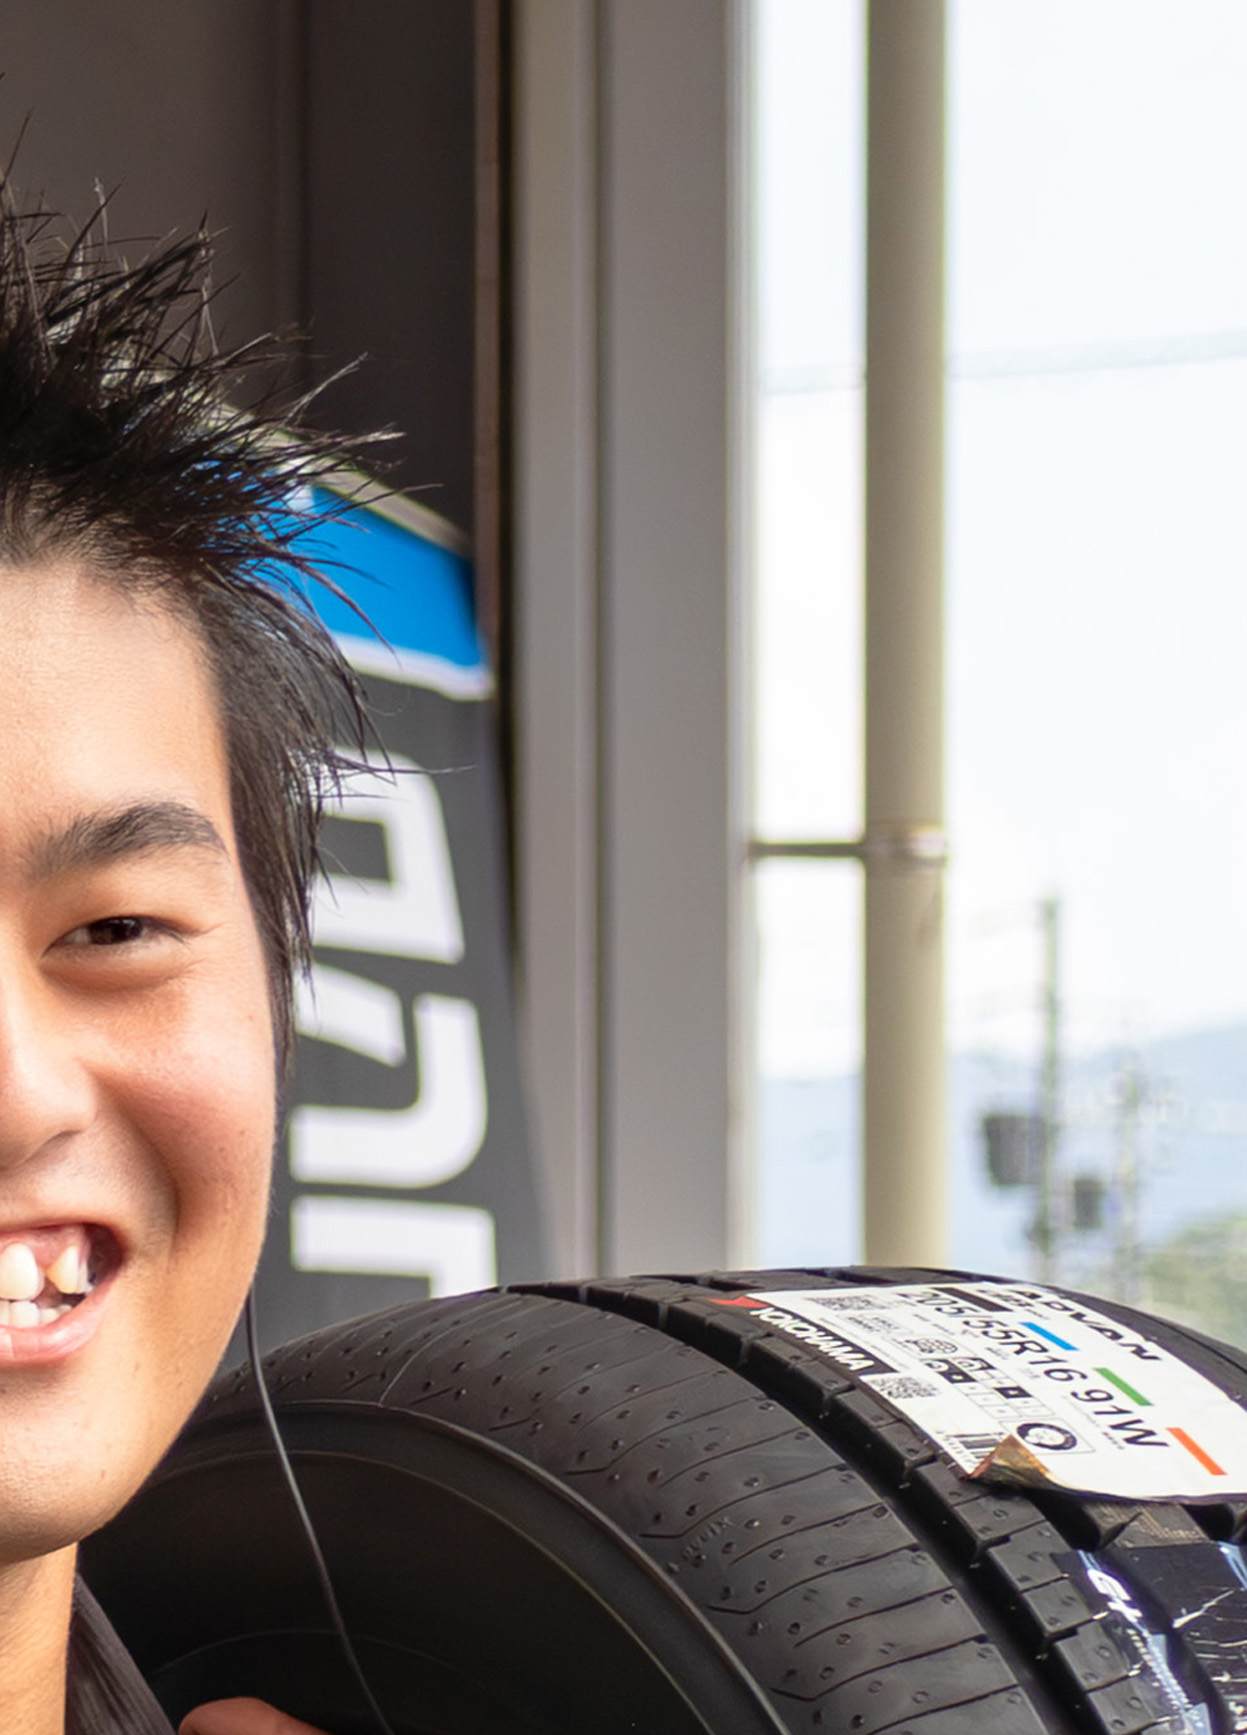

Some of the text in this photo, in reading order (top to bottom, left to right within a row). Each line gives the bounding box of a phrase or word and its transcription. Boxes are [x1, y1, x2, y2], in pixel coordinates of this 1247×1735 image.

[751, 1306, 875, 1371] YOKOHAMA
[1008, 1289, 1162, 1361] ADVAN
[896, 1291, 1088, 1382] 205/55R16
[1070, 1388, 1170, 1447] 91W
